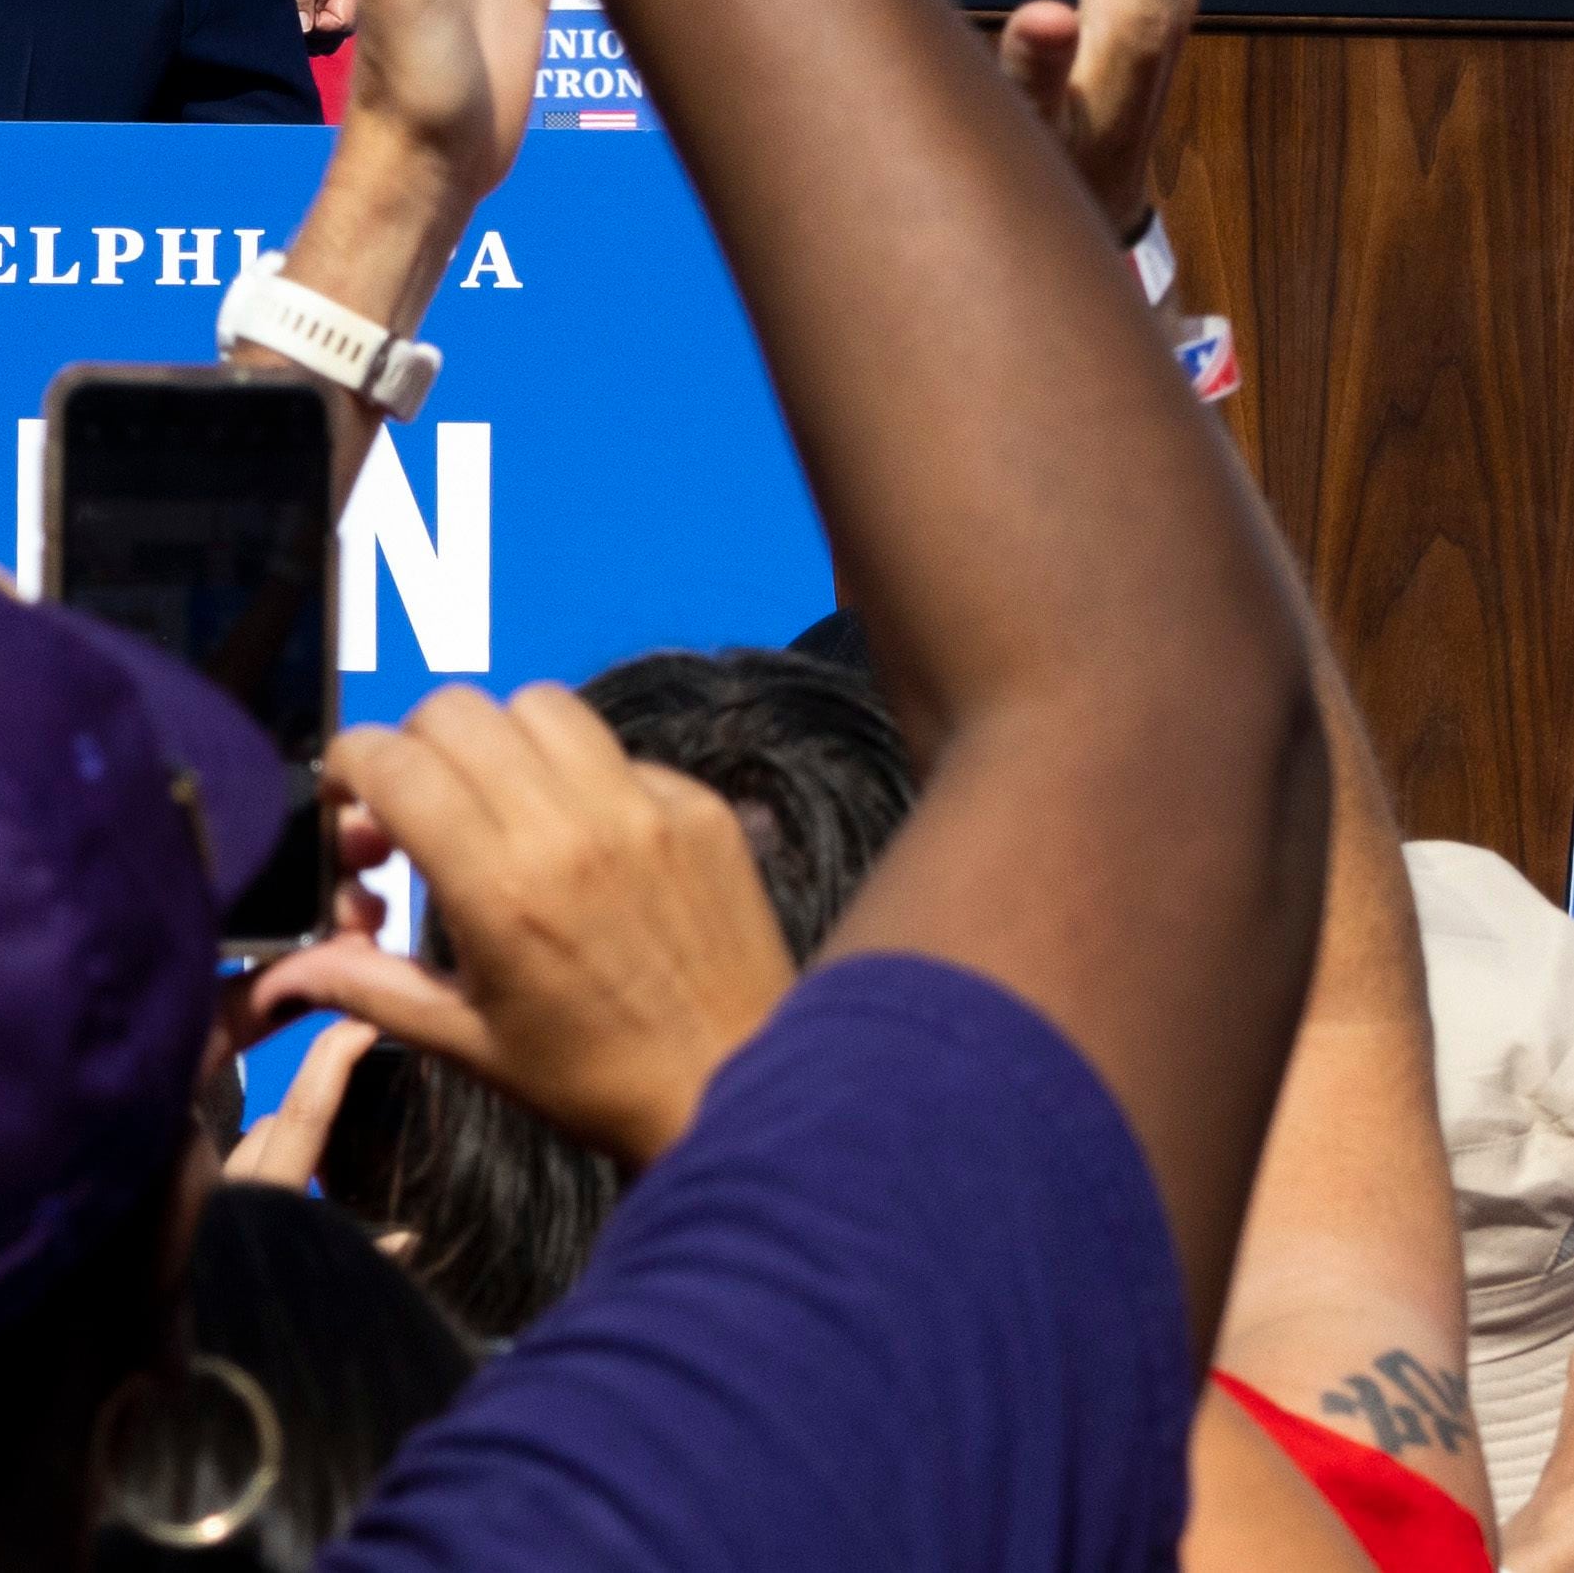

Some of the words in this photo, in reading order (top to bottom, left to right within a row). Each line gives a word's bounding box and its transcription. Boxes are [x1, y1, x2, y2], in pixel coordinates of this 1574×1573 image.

[546, 29, 624, 59] NIO
[533, 68, 643, 99] TRON
[451, 230, 524, 290] A
